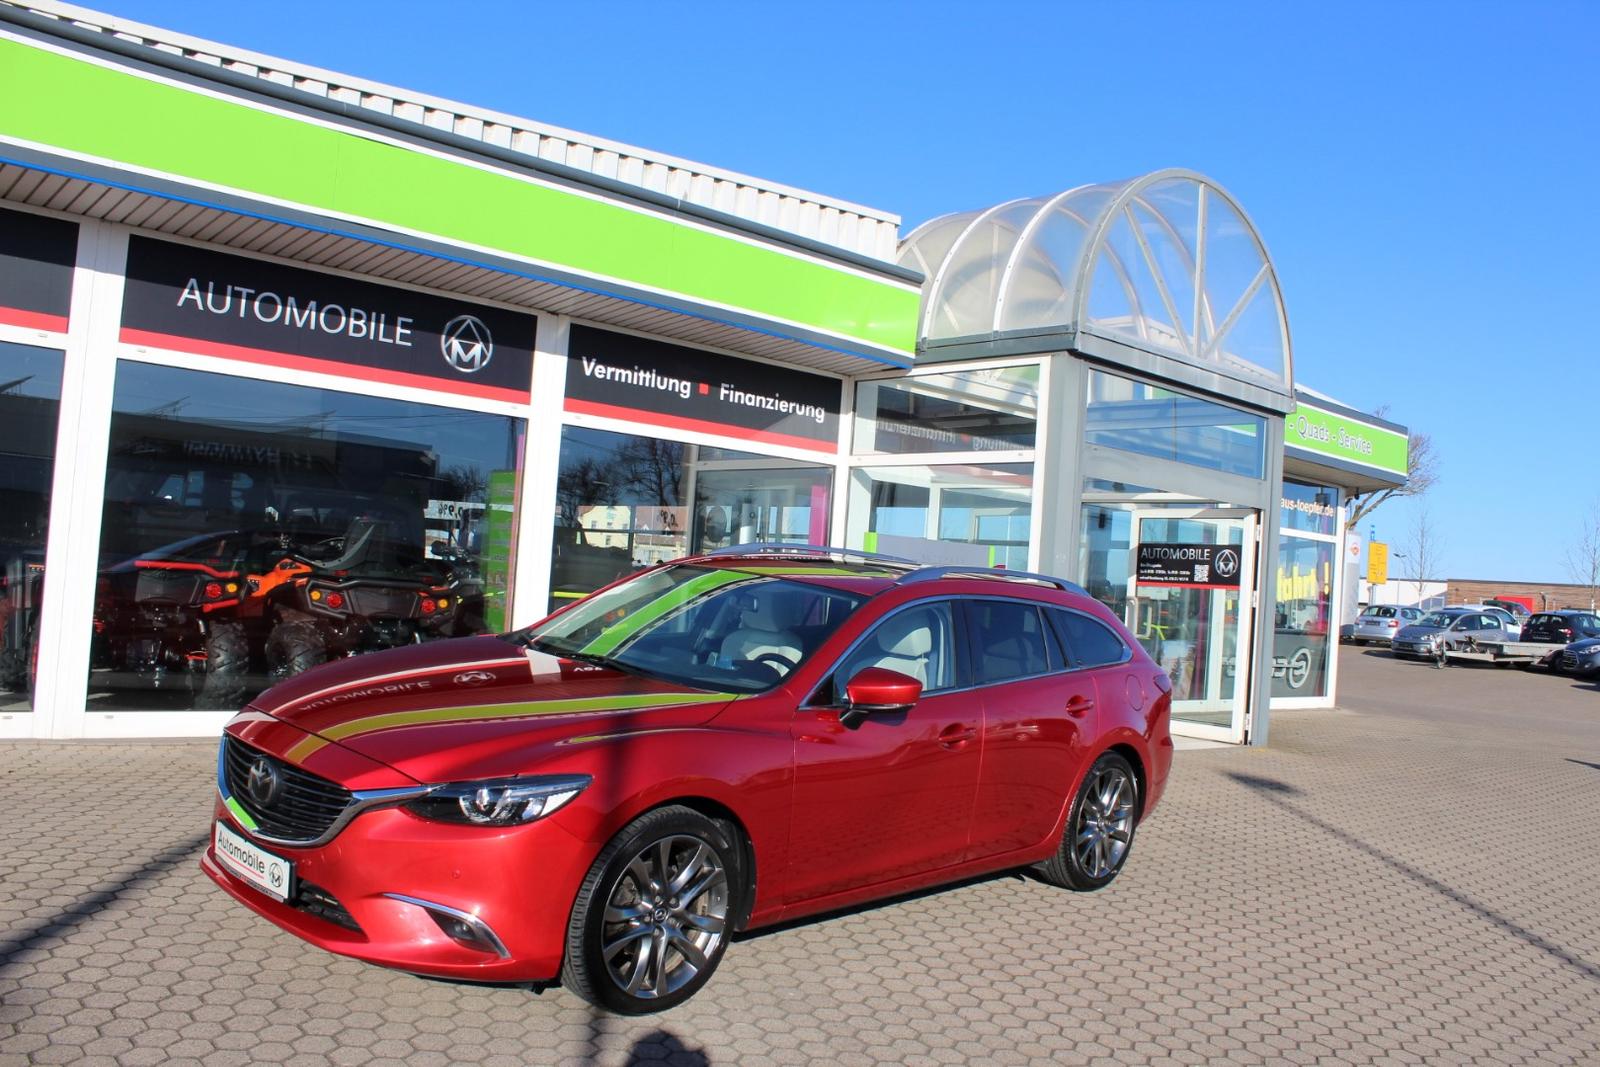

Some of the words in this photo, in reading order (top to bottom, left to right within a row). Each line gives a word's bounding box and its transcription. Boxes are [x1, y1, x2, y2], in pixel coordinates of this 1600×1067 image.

[177, 278, 413, 346] AUTOMOBILE
[582, 356, 692, 398] Vermittlung
[719, 383, 826, 423] Finanzierung
[1297, 415, 1329, 441] Quads
[1338, 427, 1372, 455] Service
[1141, 548, 1211, 560] AUTOMOBILE
[218, 831, 265, 873] Automobile
